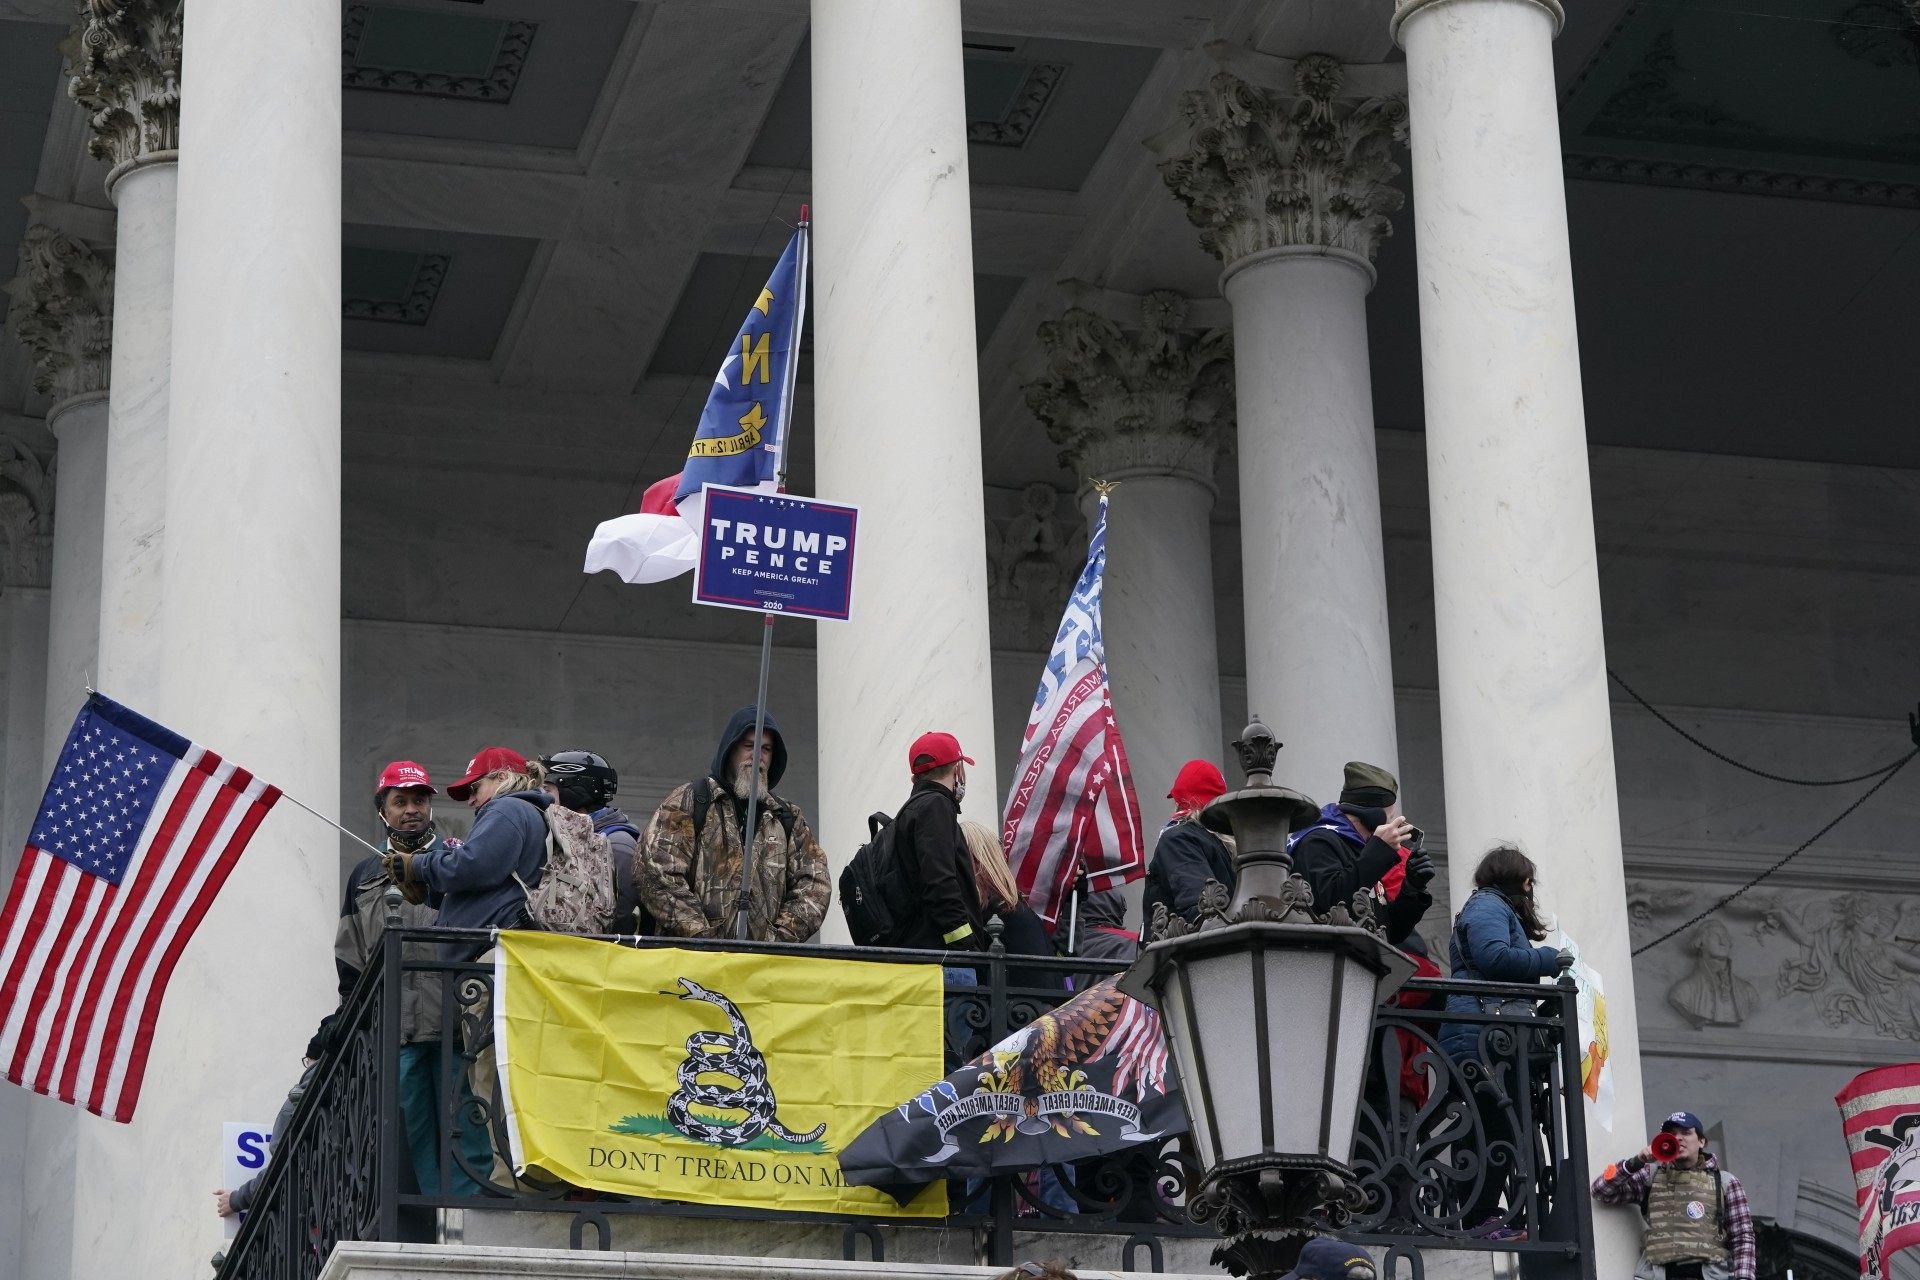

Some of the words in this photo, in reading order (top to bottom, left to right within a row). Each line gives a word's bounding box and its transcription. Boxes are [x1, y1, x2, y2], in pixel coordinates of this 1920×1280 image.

[710, 518, 847, 556] TRUMP
[721, 546, 832, 575] PENCE
[732, 567, 752, 576] KEEP
[754, 571, 789, 582] AMERICA
[791, 575, 819, 586] GREAT!
[763, 601, 783, 610] 2020
[588, 1147, 667, 1173] DONT
[674, 1155, 766, 1182] TREAD
[773, 1164, 813, 1185] ON
